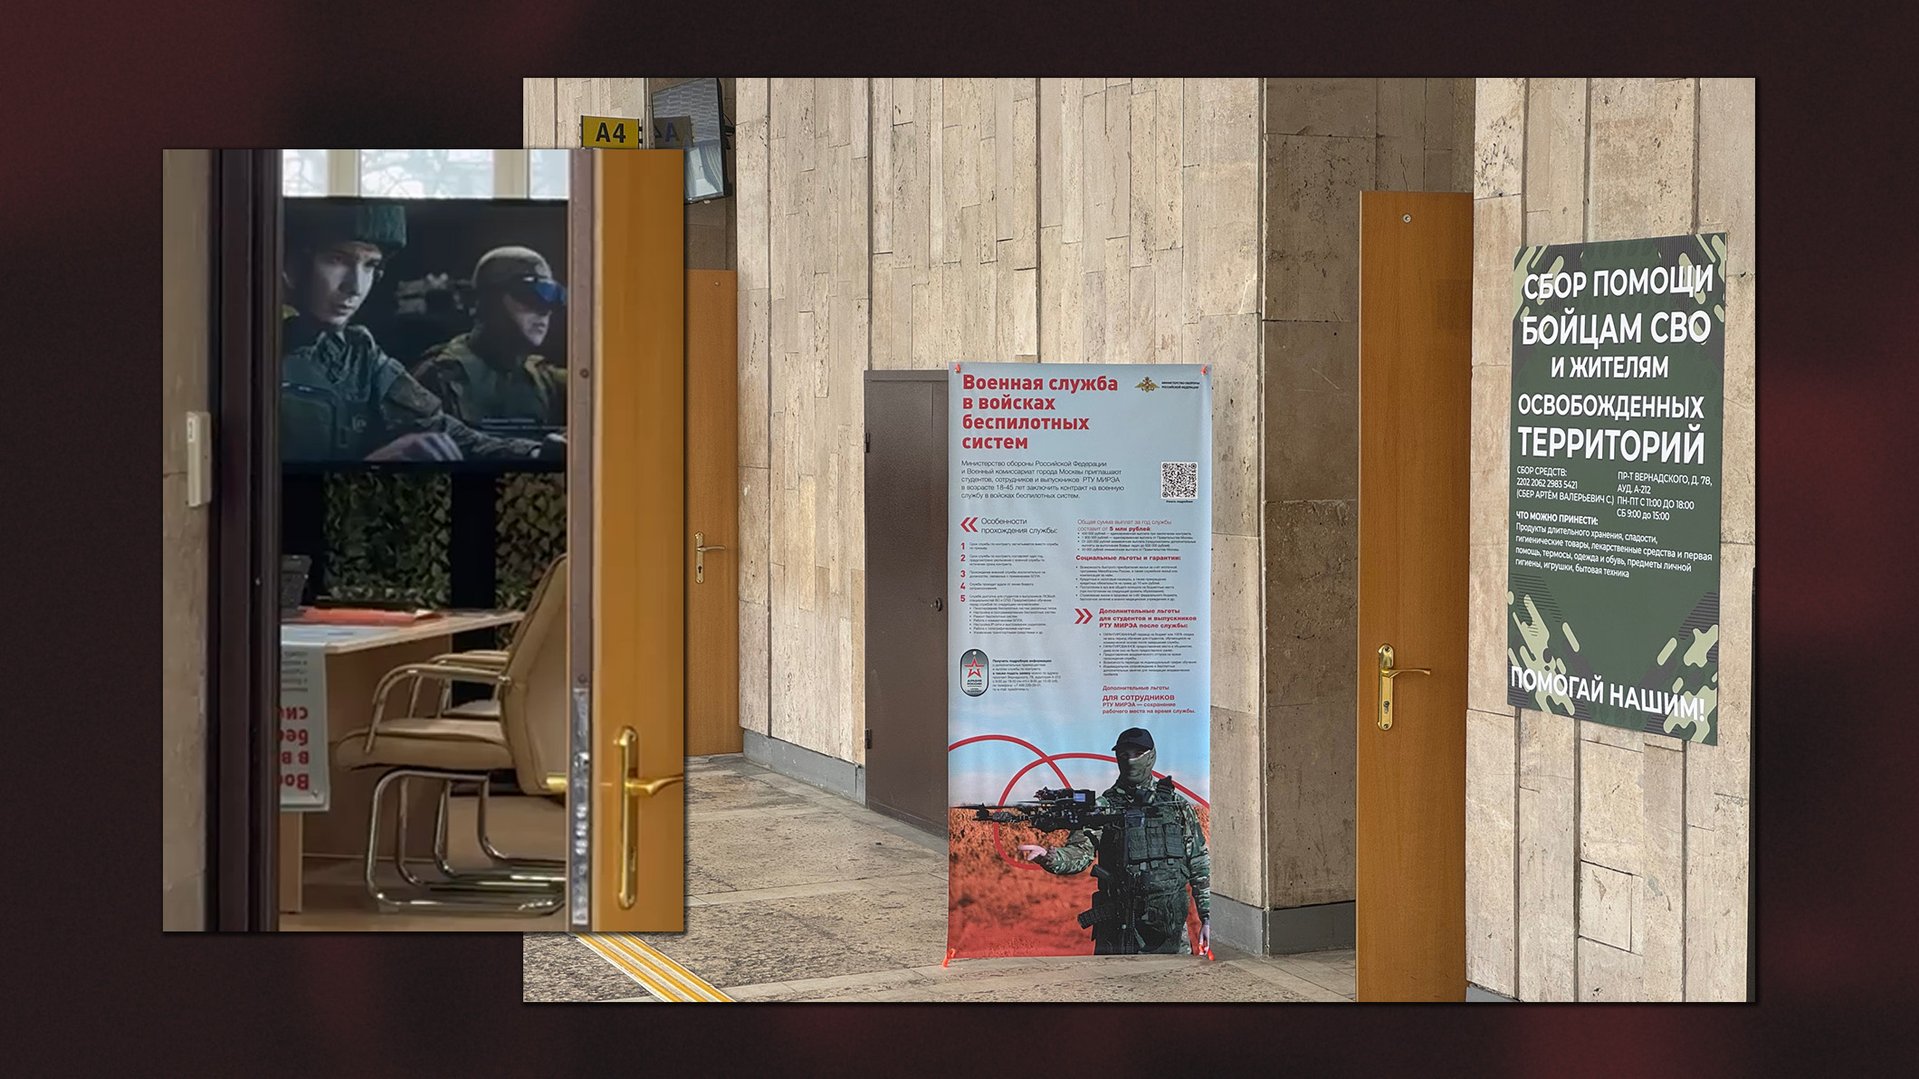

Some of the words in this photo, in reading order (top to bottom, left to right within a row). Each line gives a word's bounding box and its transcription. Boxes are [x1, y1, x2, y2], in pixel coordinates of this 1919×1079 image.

[596, 122, 626, 143] А4
[1524, 272, 1587, 300] СБОР
[1594, 264, 1713, 299] ПОМОЩИ
[1523, 308, 1642, 350] БОЙЦАМ
[1651, 310, 1712, 344] СВО
[1551, 357, 1565, 378] И
[1570, 356, 1669, 379] ЖИТЕЛЯМ
[963, 374, 1043, 391] Военная
[1049, 376, 1118, 394] служба
[963, 398, 973, 409] в
[979, 395, 1055, 410] войсках
[1519, 394, 1704, 421] ОСВОБОЖДЕННЫХ
[963, 415, 1090, 430] беспилотных
[962, 435, 1028, 449] систем
[1518, 424, 1704, 465] ТЕРРИТОРИЙ
[1517, 466, 1534, 474] СБОР
[1535, 467, 1567, 477] СРЕДСТВ:
[1517, 478, 1530, 486] 2202
[1531, 479, 1546, 487] 2062
[1547, 480, 1562, 488] 2983
[1564, 481, 1577, 489] 5421
[1618, 472, 1634, 480] ПР-Т
[1635, 473, 1690, 485] ВЕРНАДСКОГО,
[1691, 476, 1699, 486] Д.
[1701, 476, 1713, 487] 78,
[1617, 484, 1632, 494] АУД.
[1634, 485, 1651, 494] А-212
[1517, 489, 1534, 498] (СБЕР
[1536, 490, 1558, 500] АРТЁМ
[1560, 492, 1604, 503] ВАЛЕРЬЕВИЧ
[1606, 495, 1614, 505] С.)
[1617, 496, 1639, 506] ПН-ПТ
[1640, 498, 1645, 506] С
[1646, 498, 1662, 507] 11:00
[1663, 500, 1674, 509] ДО
[1676, 501, 1694, 510] 18:00
[1516, 511, 1529, 519] ЧТО
[1530, 512, 1558, 522] МОЖНО
[1559, 514, 1598, 525] ПРИНЕСТИ:
[1617, 509, 1626, 517] СБ
[1627, 510, 1641, 518] 9:00
[1653, 511, 1670, 520] 15:00
[981, 527, 1027, 535] прохождения
[1029, 527, 1057, 535] службы:
[1516, 522, 1546, 533] Продукты
[1547, 527, 1590, 537] длительного
[1591, 531, 1624, 541] хранения,
[1625, 534, 1658, 545] сладости,
[961, 542, 965, 550] 1
[1516, 536, 1564, 546] гигиенические
[1565, 540, 1590, 550] товары,
[1591, 543, 1642, 554] лекарственные
[1643, 548, 1675, 557] средства
[1684, 551, 1712, 561] первая
[960, 554, 966, 562] 2
[1516, 547, 1541, 557] помощь,
[1543, 550, 1573, 560] термосы,
[1574, 553, 1599, 563] одежда
[1606, 555, 1626, 566] обувь,
[1627, 558, 1662, 568] предметы
[1664, 563, 1691, 572] личной
[960, 570, 966, 578] 3
[1516, 559, 1543, 569] гигиены,
[1544, 562, 1574, 572] игрушки,
[1575, 564, 1602, 574] бытовая
[1604, 568, 1629, 578] техника
[960, 582, 966, 590] 4
[960, 594, 966, 602] 5
[1511, 666, 1604, 703] ПОМОГАЙ
[1610, 684, 1706, 722] НАШИМ!
